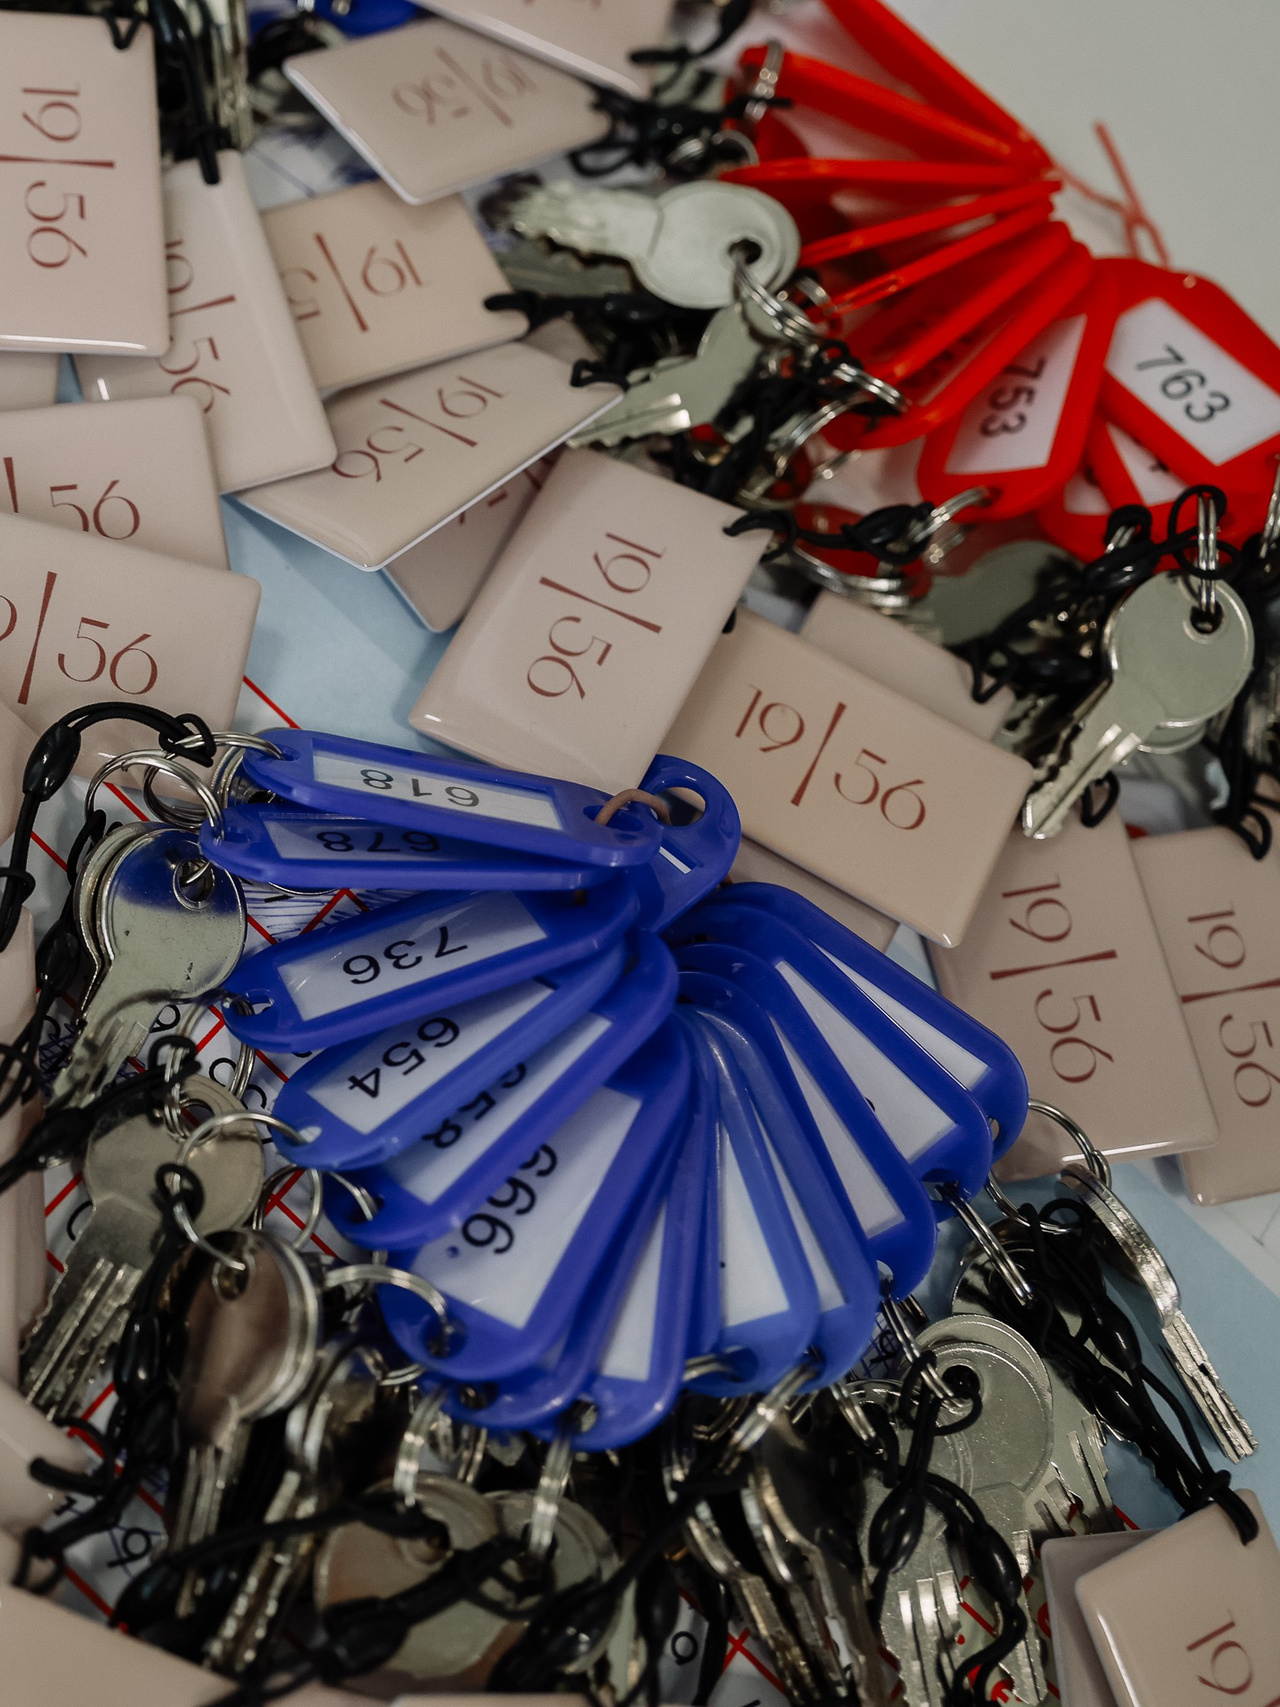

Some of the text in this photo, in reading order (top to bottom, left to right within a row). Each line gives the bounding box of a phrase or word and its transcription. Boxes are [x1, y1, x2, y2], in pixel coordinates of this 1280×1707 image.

[979, 356, 1047, 438] 753
[1135, 343, 1232, 424] 763
[360, 768, 481, 809] 618
[315, 829, 442, 854] 678
[341, 925, 469, 986] 736
[347, 1016, 461, 1099] 654
